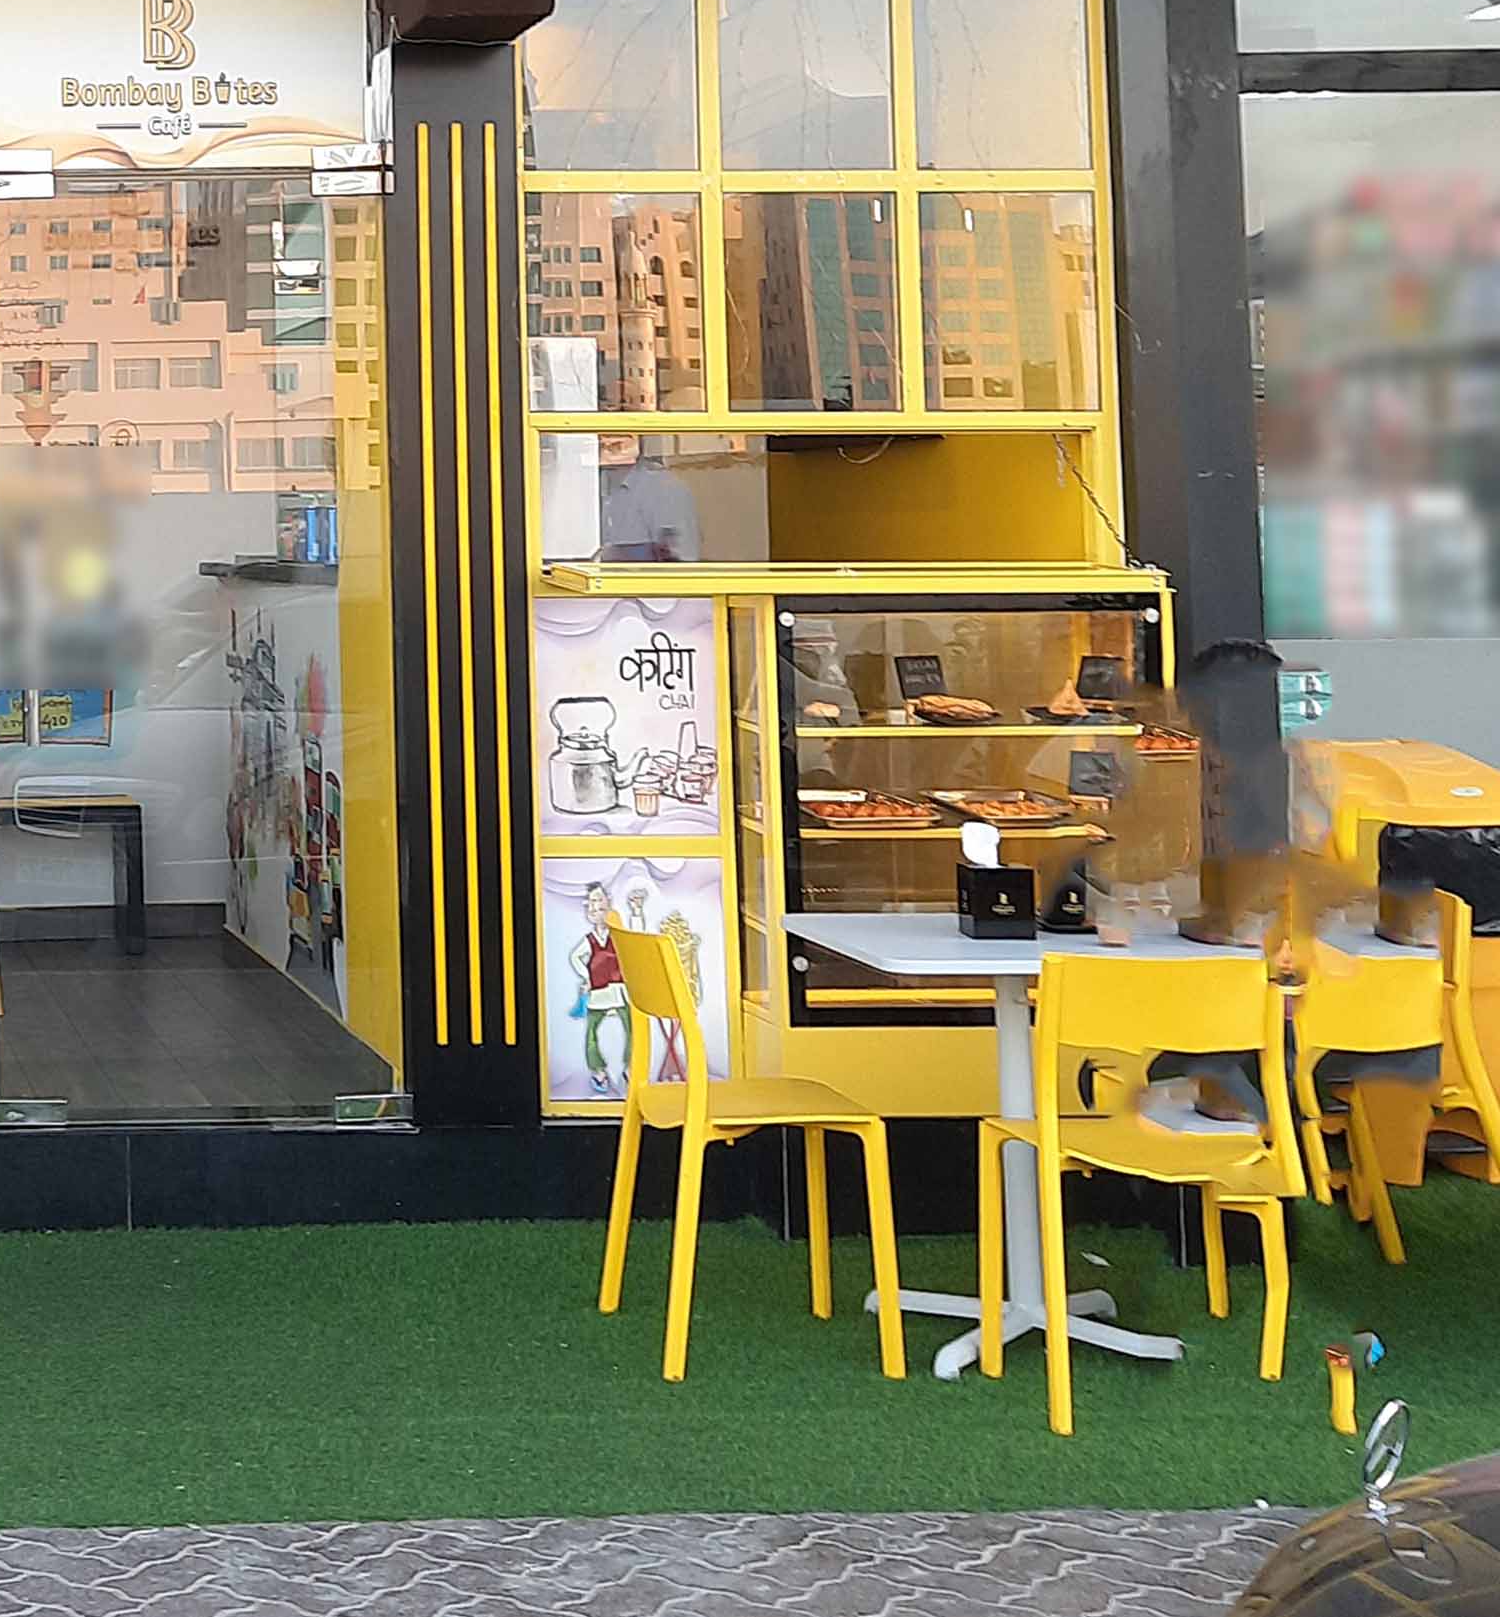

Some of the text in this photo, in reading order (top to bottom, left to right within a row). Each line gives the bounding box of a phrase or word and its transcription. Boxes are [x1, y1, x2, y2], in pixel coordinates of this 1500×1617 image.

[61, 76, 183, 112] Bombay
[149, 114, 192, 138] Café
[620, 631, 697, 693] कटिंग
